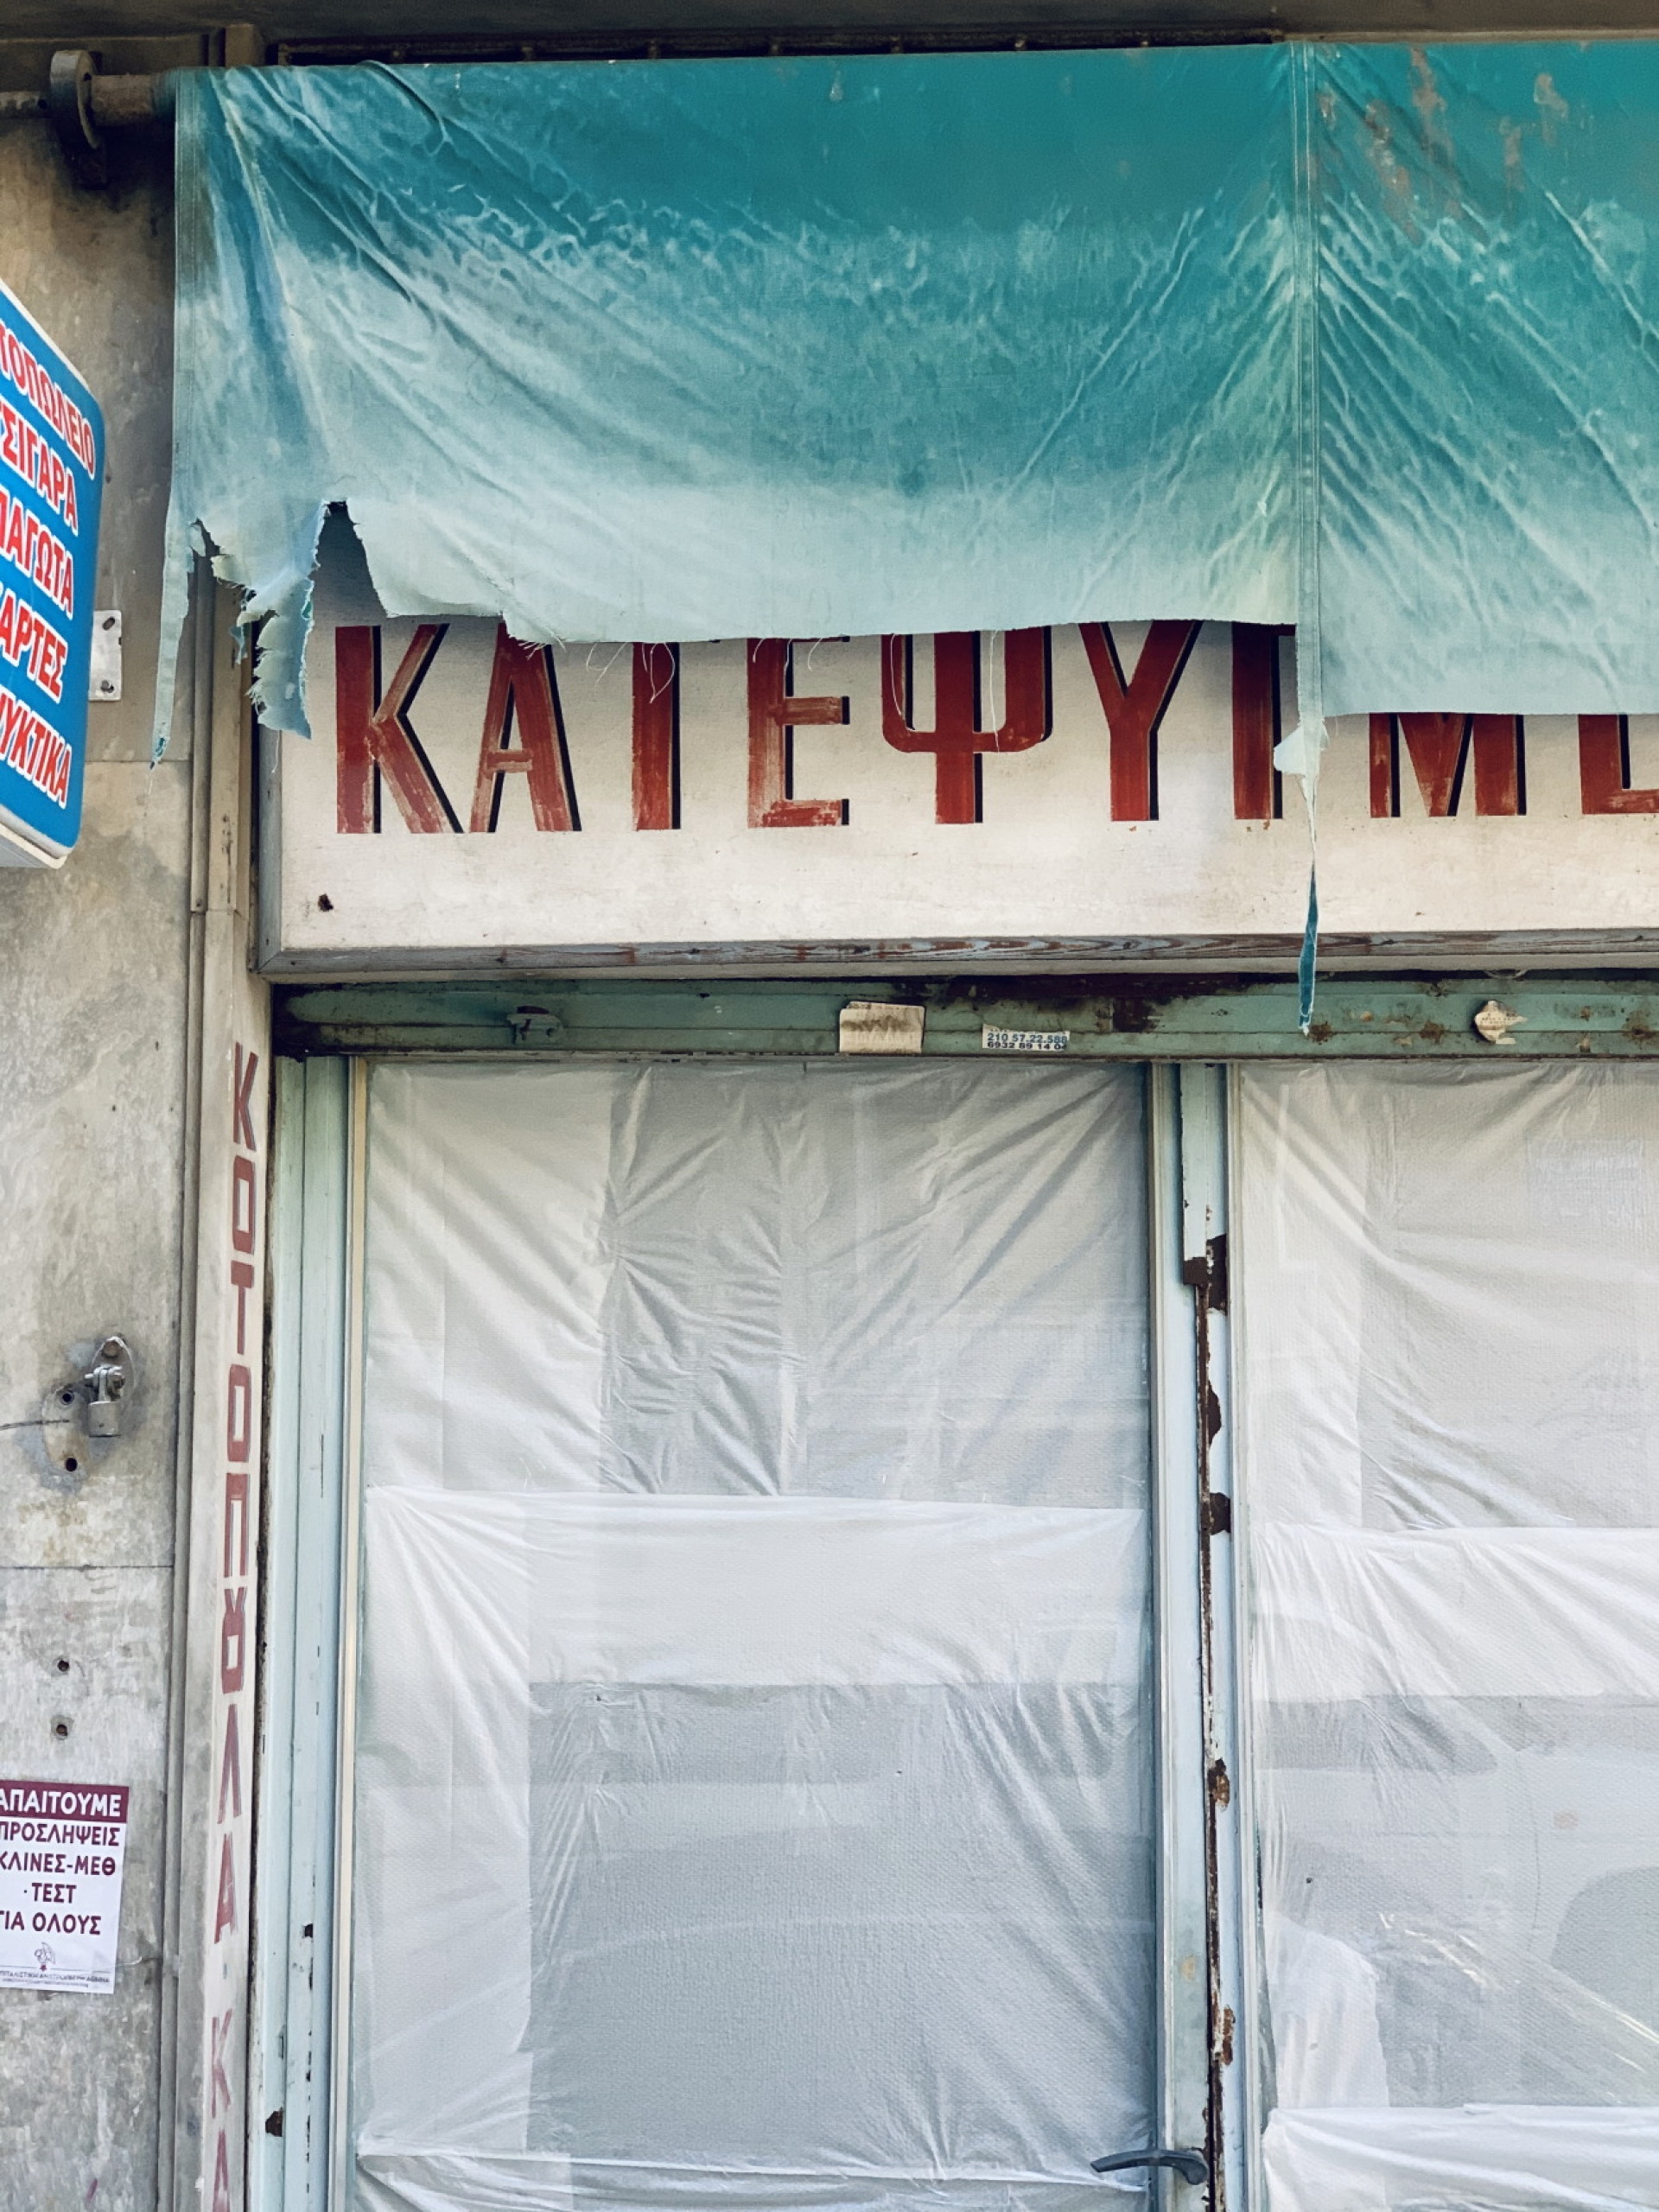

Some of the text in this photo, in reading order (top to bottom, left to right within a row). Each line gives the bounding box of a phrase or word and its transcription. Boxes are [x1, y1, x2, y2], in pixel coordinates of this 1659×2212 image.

[0, 401, 77, 530] ΣΙΓΑΡΑ
[987, 1032, 1008, 1041] 210
[0, 1789, 122, 1817] ΑΠΑΙΤΟΥΜΕ
[32, 1882, 77, 1904] ΤΕΣΤ
[32, 1911, 101, 1936] ΟΛΟΥΣ
